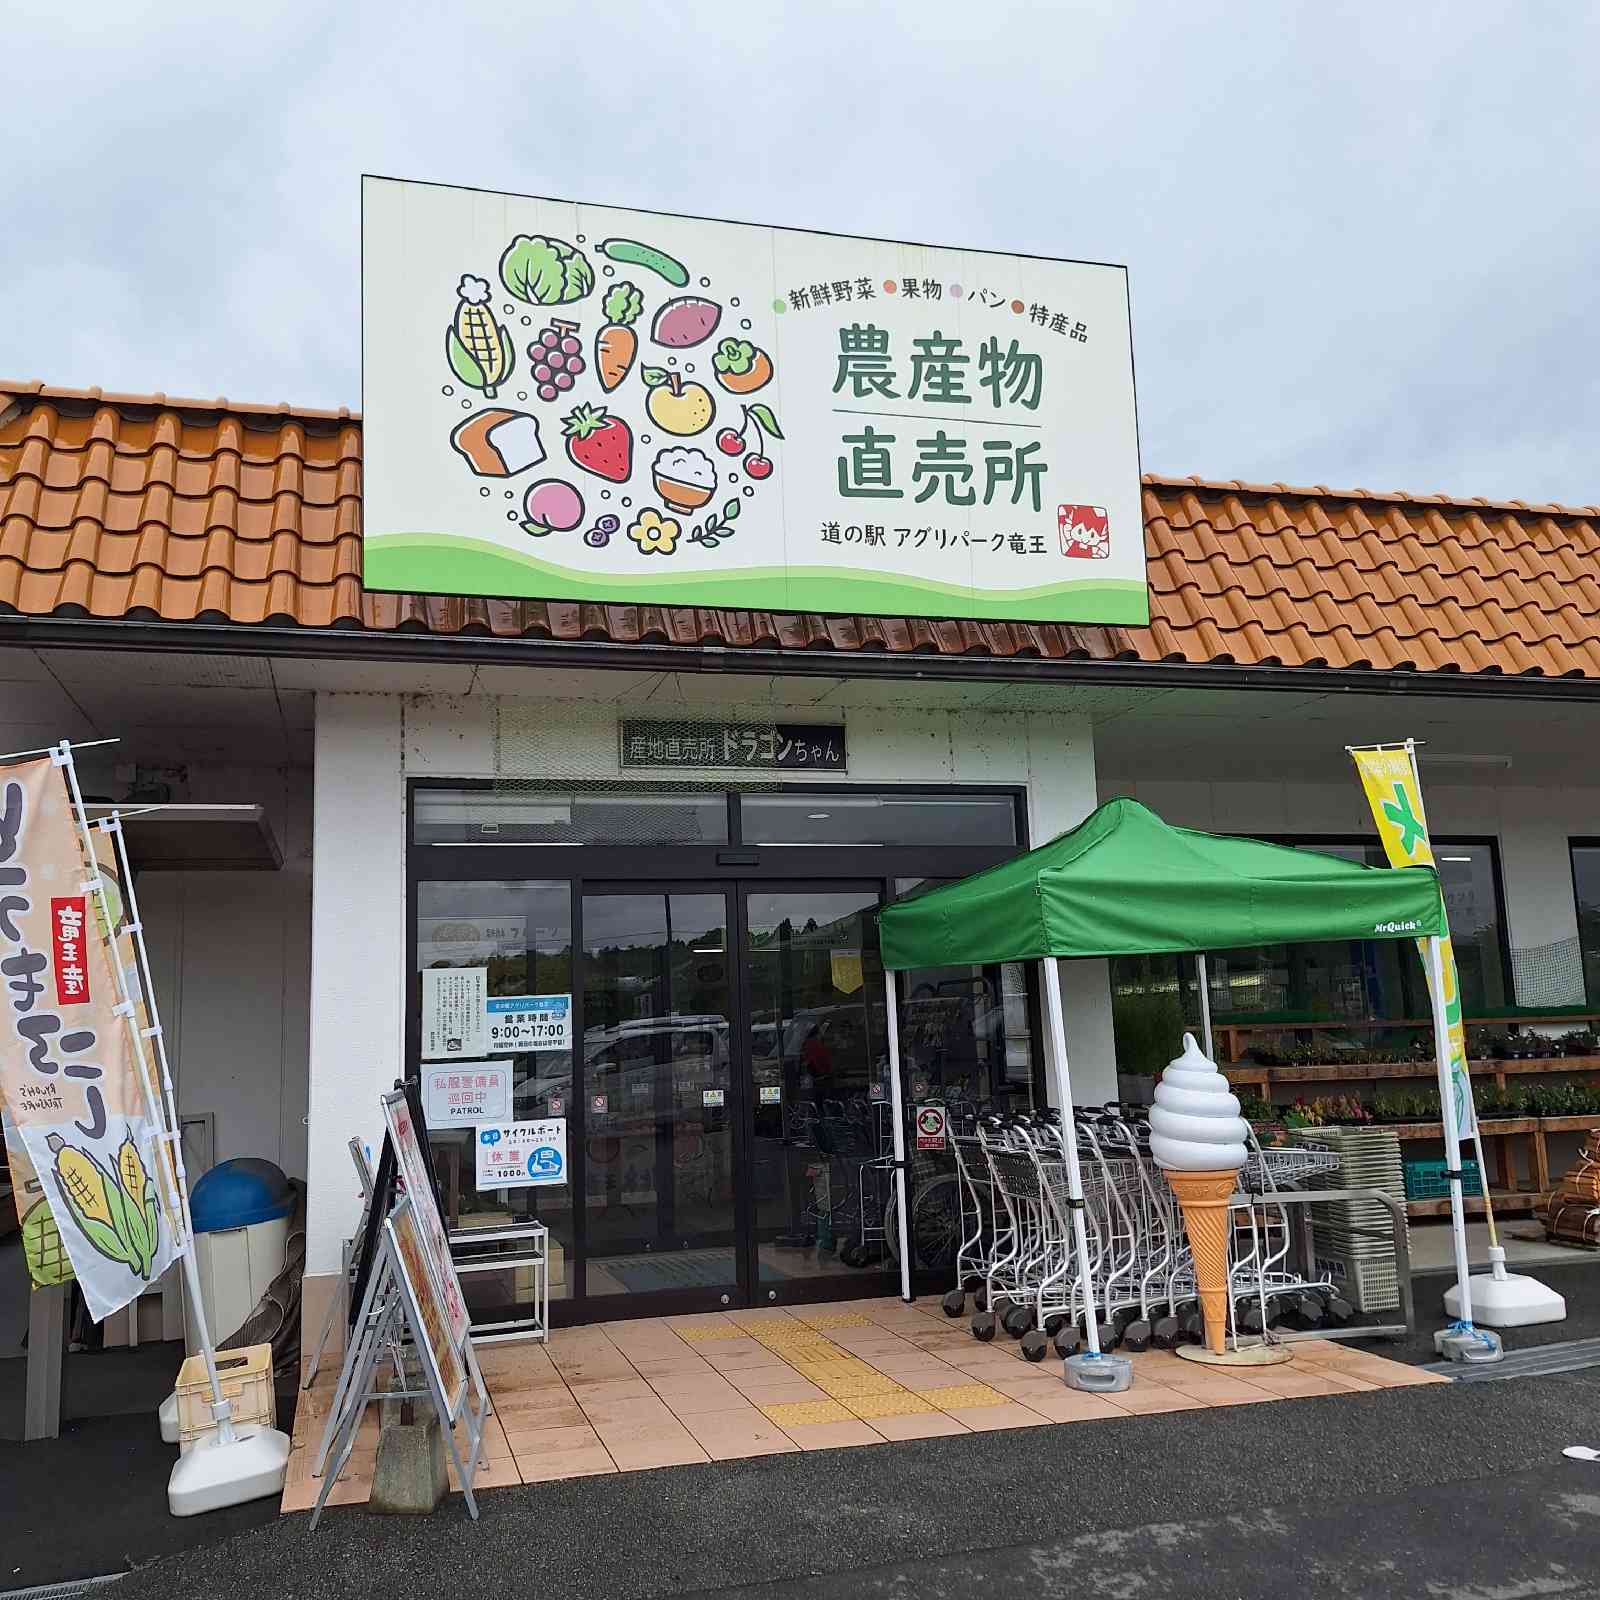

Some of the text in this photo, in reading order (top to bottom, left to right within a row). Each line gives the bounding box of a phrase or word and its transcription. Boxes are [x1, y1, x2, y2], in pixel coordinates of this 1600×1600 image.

[788, 277, 1089, 344] 新鮮野菜 果物 パン 特産品
[832, 322, 1043, 411] 農産物
[837, 425, 1048, 512] 直売所
[820, 521, 1048, 555] 道の駅 アグリパーク竜王
[450, 1106, 485, 1115] PATROL
